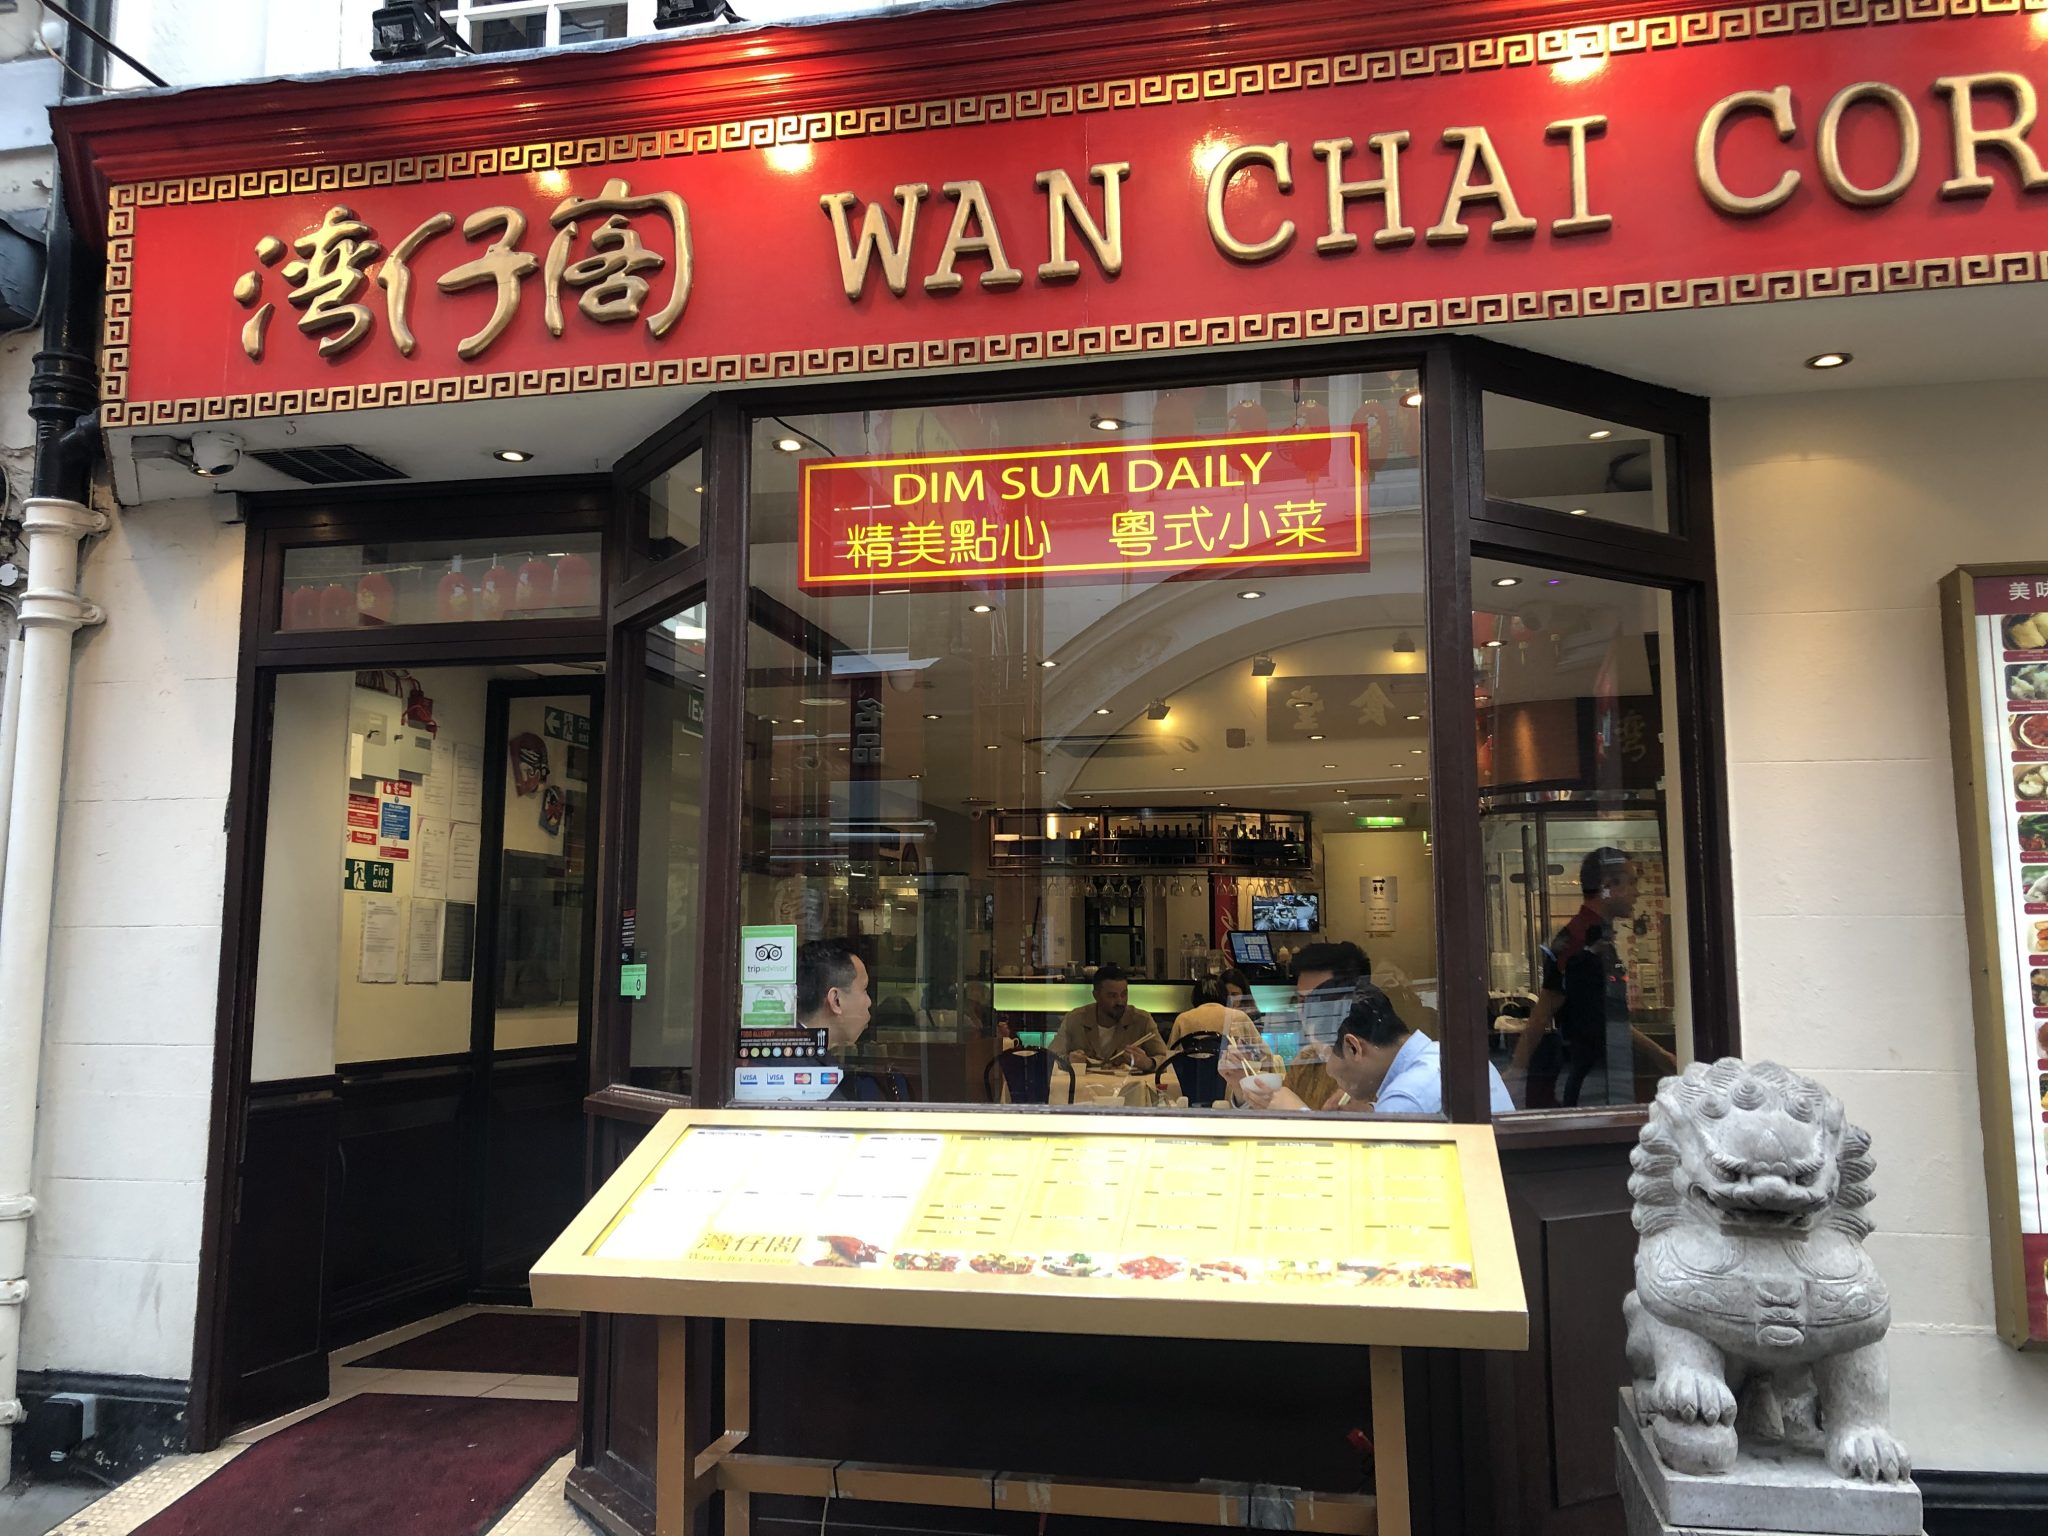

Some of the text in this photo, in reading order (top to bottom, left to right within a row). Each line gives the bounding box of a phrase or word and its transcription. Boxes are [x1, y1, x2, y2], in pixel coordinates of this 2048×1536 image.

[820, 70, 2048, 301] WAN CHAI COR
[893, 451, 1273, 506] DIM SUM DAILY
[846, 515, 1052, 569] 精美點心
[372, 864, 390, 877] Fire
[372, 878, 388, 889] exit
[747, 965, 788, 974] tripadvisor
